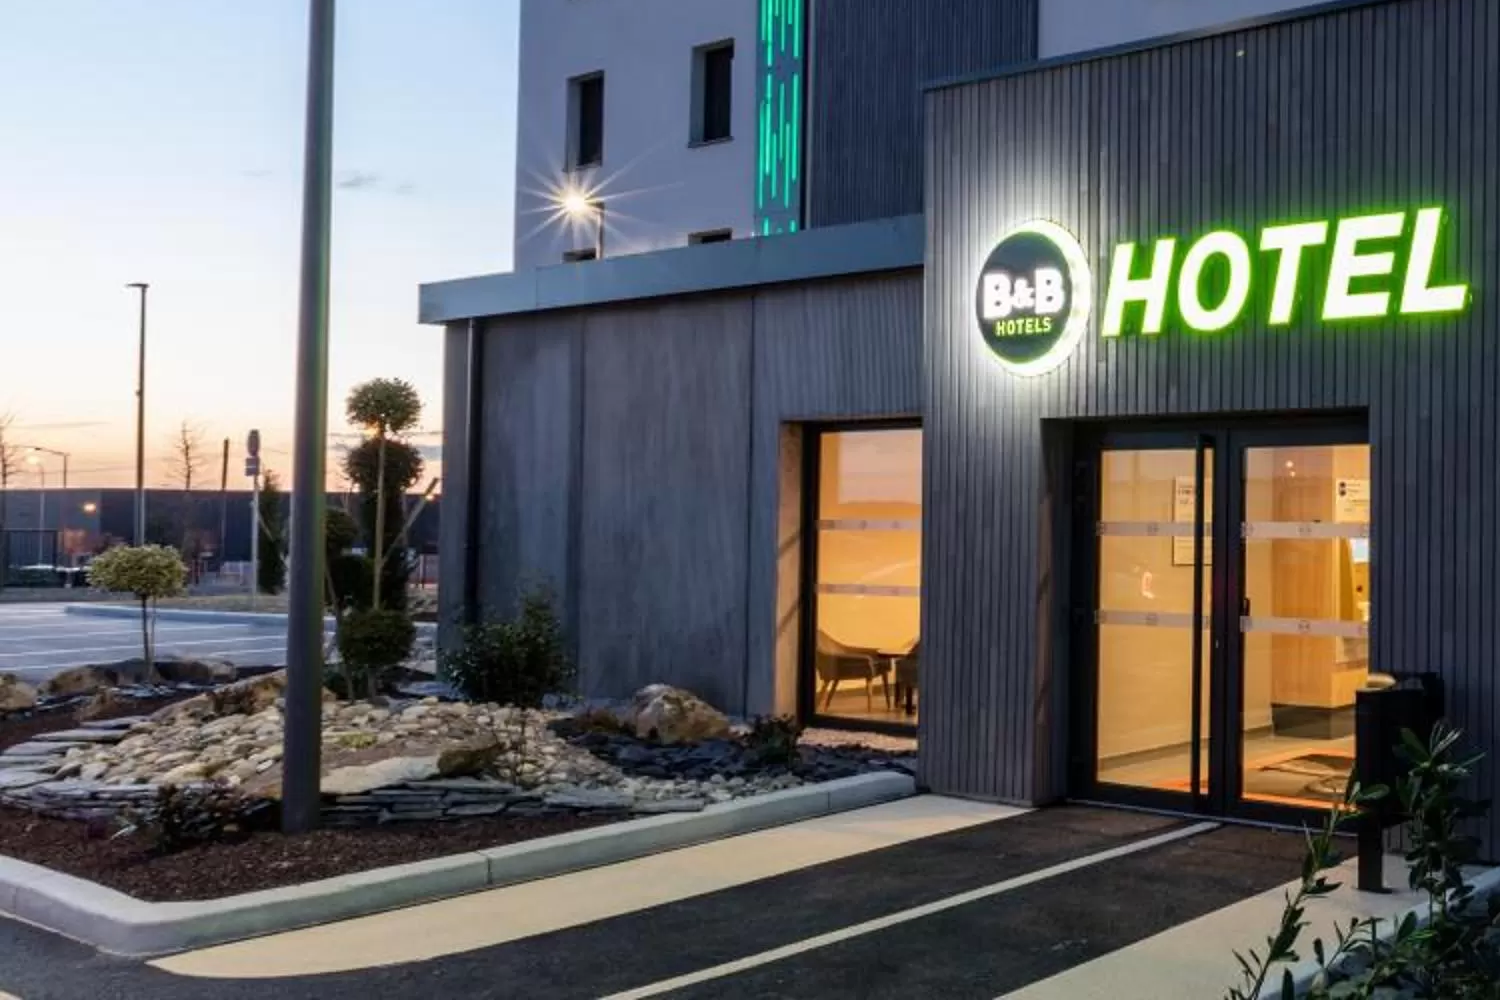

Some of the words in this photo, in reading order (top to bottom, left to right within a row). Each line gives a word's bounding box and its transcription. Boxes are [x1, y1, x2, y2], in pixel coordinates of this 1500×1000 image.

[983, 267, 1066, 319] B&B
[1101, 206, 1470, 338] HOTEL
[995, 316, 1052, 337] HOTELS
